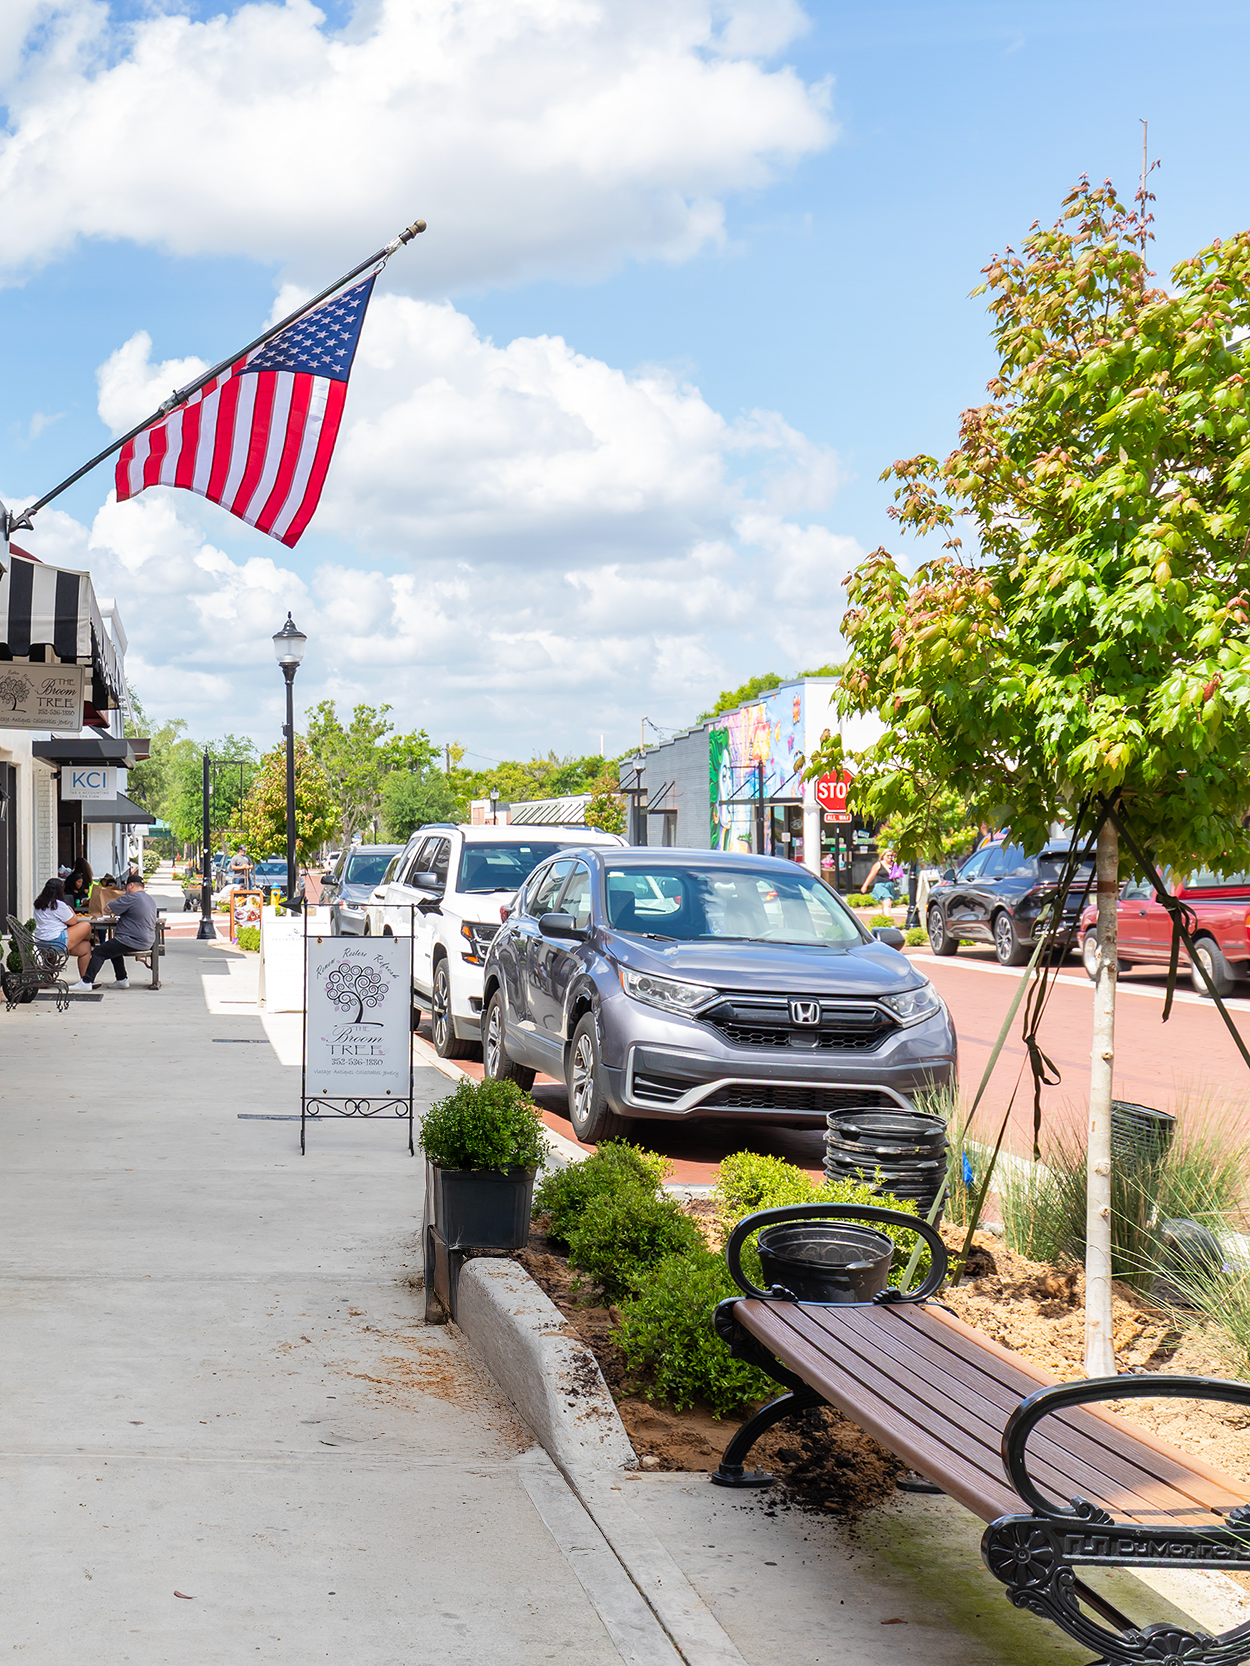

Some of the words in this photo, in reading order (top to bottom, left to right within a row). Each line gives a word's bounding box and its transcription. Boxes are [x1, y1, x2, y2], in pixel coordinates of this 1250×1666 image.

[36, 677, 77, 696] Broom
[36, 697, 75, 709] TREE
[72, 772, 106, 789] KCI
[819, 782, 849, 798] STO
[326, 1025, 384, 1044] Broom
[326, 1044, 386, 1056] TREE
